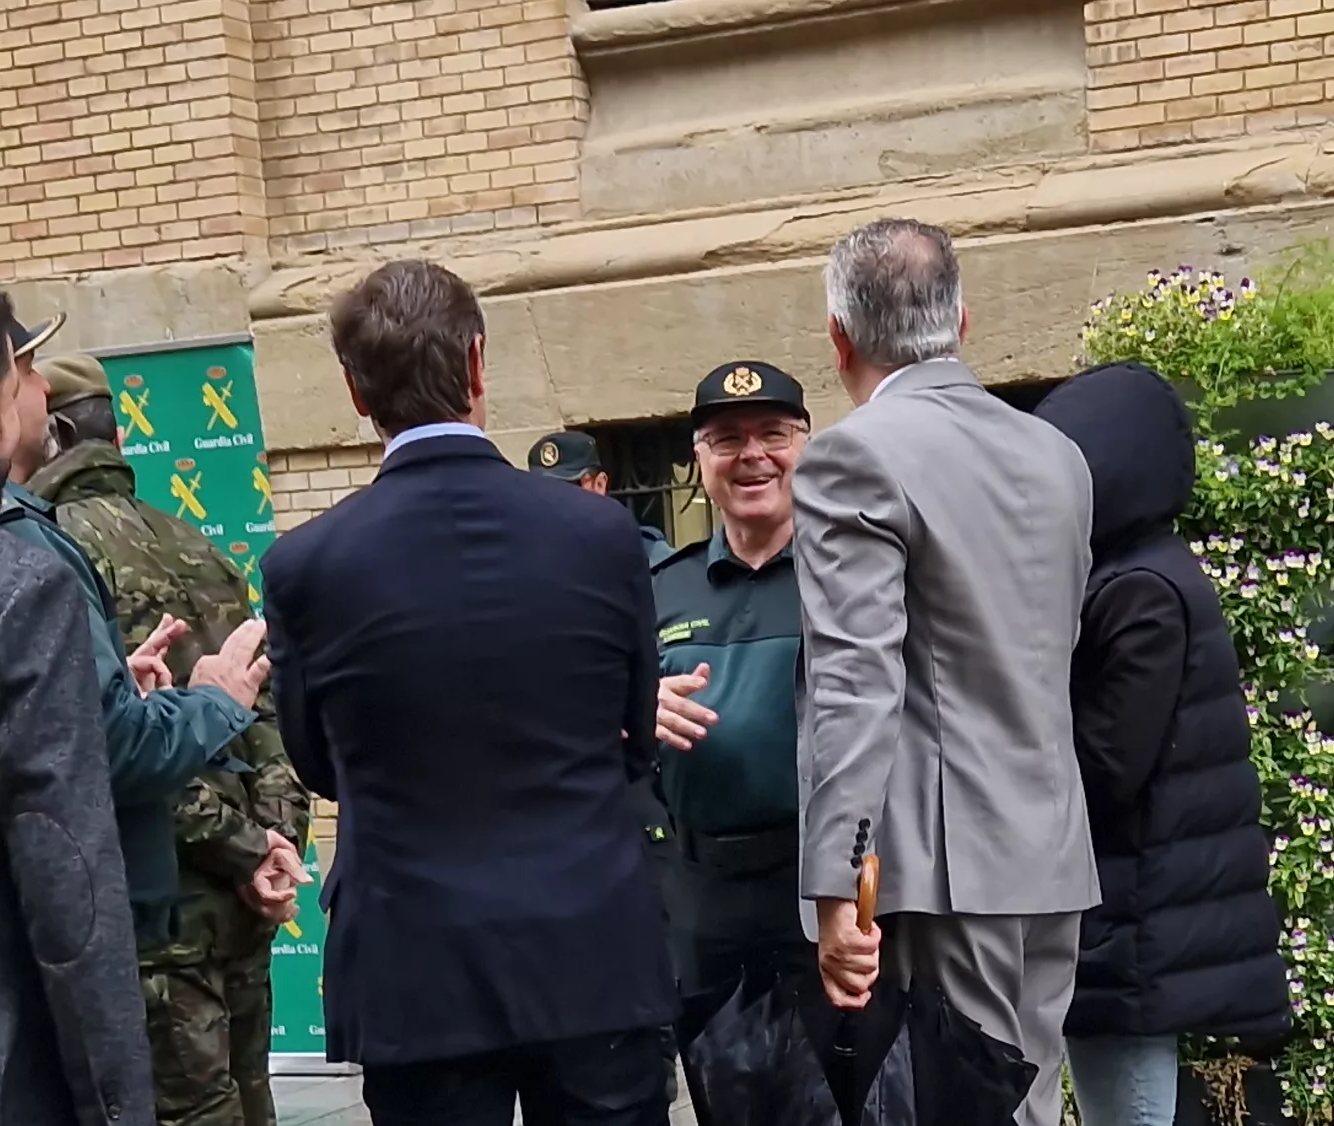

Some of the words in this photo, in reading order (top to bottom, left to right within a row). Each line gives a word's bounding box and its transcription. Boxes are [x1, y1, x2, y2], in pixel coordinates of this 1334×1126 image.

[121, 442, 148, 456] uardia
[148, 440, 170, 454] Civil
[194, 436, 232, 449] Guardia
[232, 433, 254, 446] Civil
[200, 523, 224, 536] Civil
[245, 519, 275, 533] Guardi
[296, 943, 319, 954] Civil
